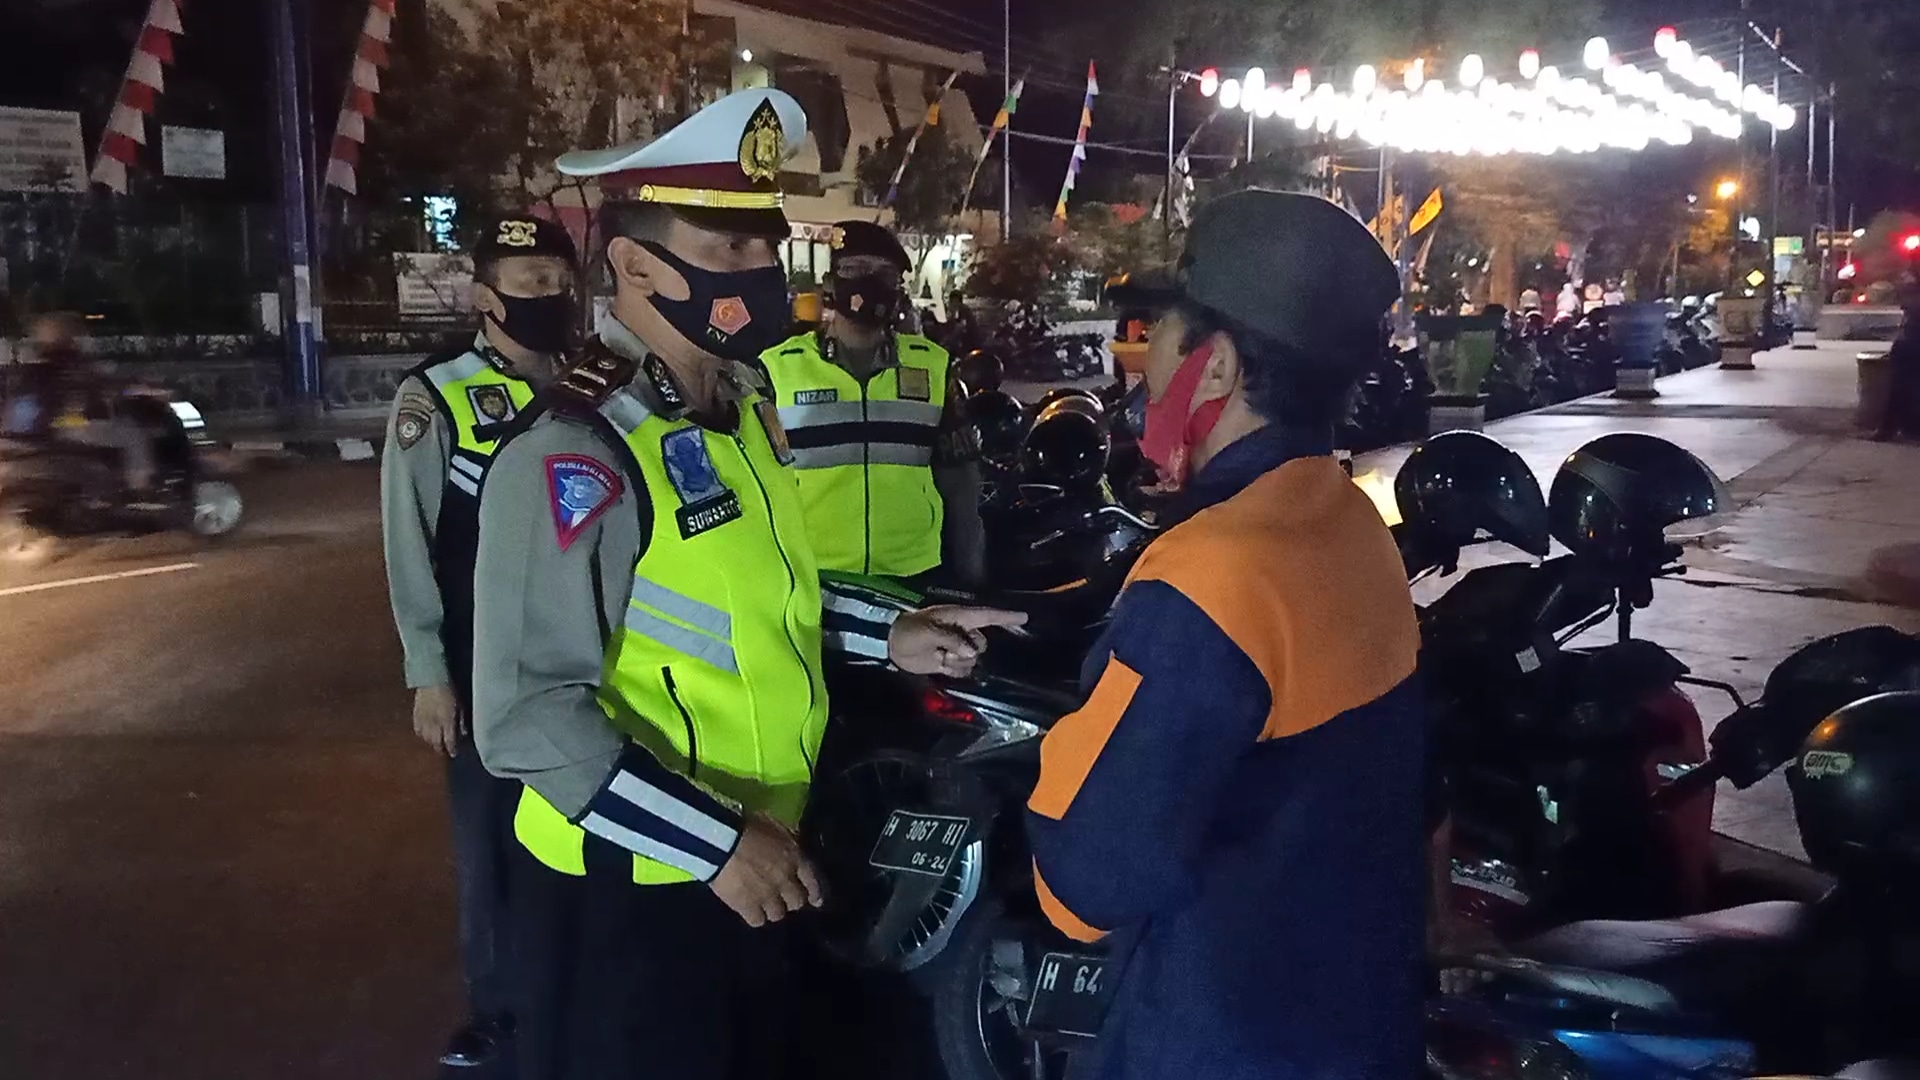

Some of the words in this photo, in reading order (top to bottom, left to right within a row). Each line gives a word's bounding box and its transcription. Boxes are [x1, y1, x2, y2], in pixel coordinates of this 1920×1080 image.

[796, 390, 835, 405] NIZAR
[884, 815, 900, 838] H
[904, 819, 940, 843] 3067
[941, 823, 964, 847] HI
[1042, 960, 1061, 992] H
